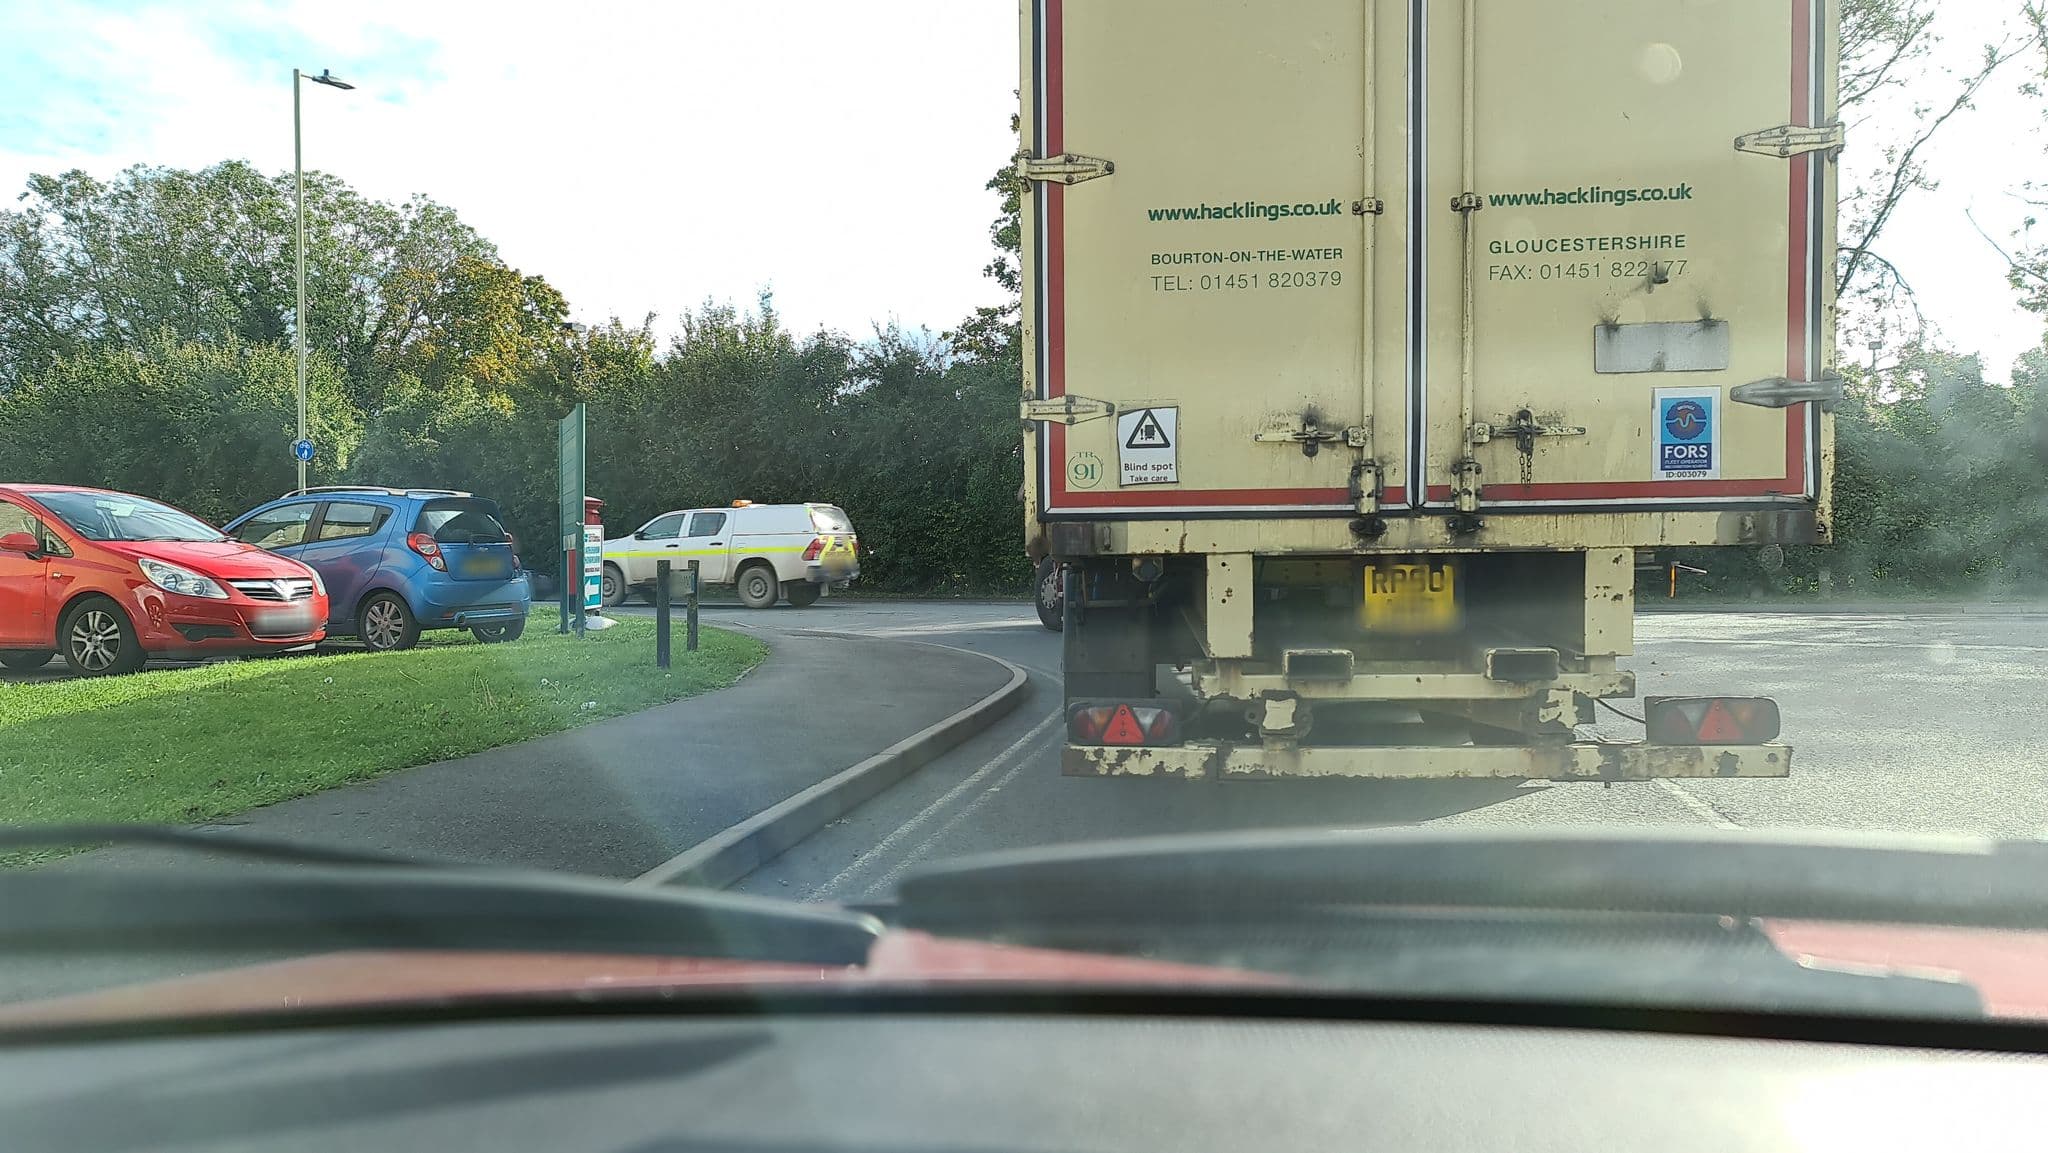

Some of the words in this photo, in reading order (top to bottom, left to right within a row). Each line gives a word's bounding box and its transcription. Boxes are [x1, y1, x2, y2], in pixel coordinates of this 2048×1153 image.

[1488, 183, 1693, 207] www.hacklings.co.uk
[1148, 198, 1342, 221] www.hacklings.co.uk
[1489, 234, 1686, 254] GLOUCESTERSHIRE
[1151, 248, 1343, 265] BOURTON-ON-THE-WATER
[1489, 264, 1532, 280] FAX:
[1540, 262, 1600, 280] 01451
[1611, 259, 1687, 278] 822177
[1150, 275, 1193, 291] TEL:
[1200, 273, 1258, 290] 01451
[1268, 270, 1342, 289] 820379
[1664, 445, 1708, 459] FORS
[1074, 463, 1095, 480] 91
[1124, 463, 1148, 471] Blind
[1151, 463, 1174, 472] spot
